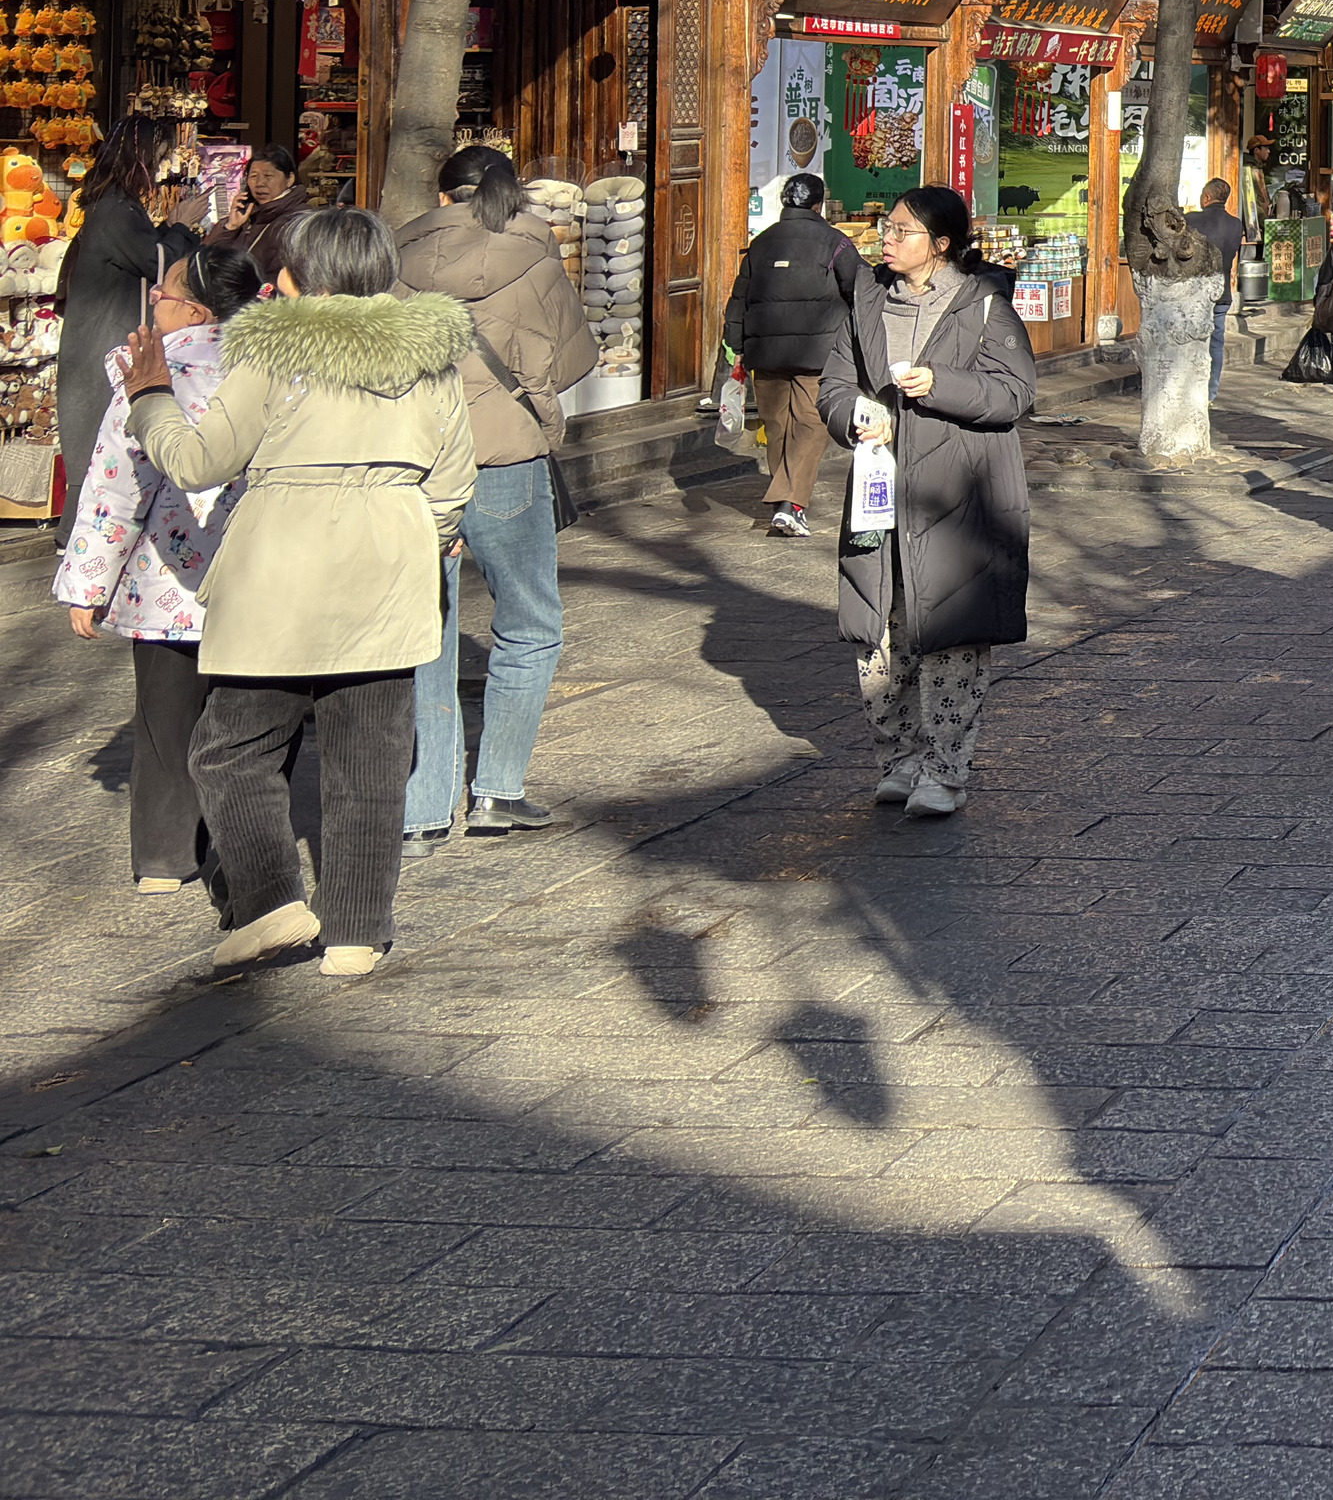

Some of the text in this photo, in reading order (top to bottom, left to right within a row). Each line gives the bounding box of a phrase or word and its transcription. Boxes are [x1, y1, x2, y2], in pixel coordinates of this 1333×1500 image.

[981, 31, 1118, 62] 一站式购物 一件也批发
[796, 65, 814, 94] 古树
[895, 58, 924, 84] 云南
[785, 82, 821, 123] 普洱
[1014, 288, 1041, 301] 茸酱
[1015, 303, 1044, 318] 元/8瓶
